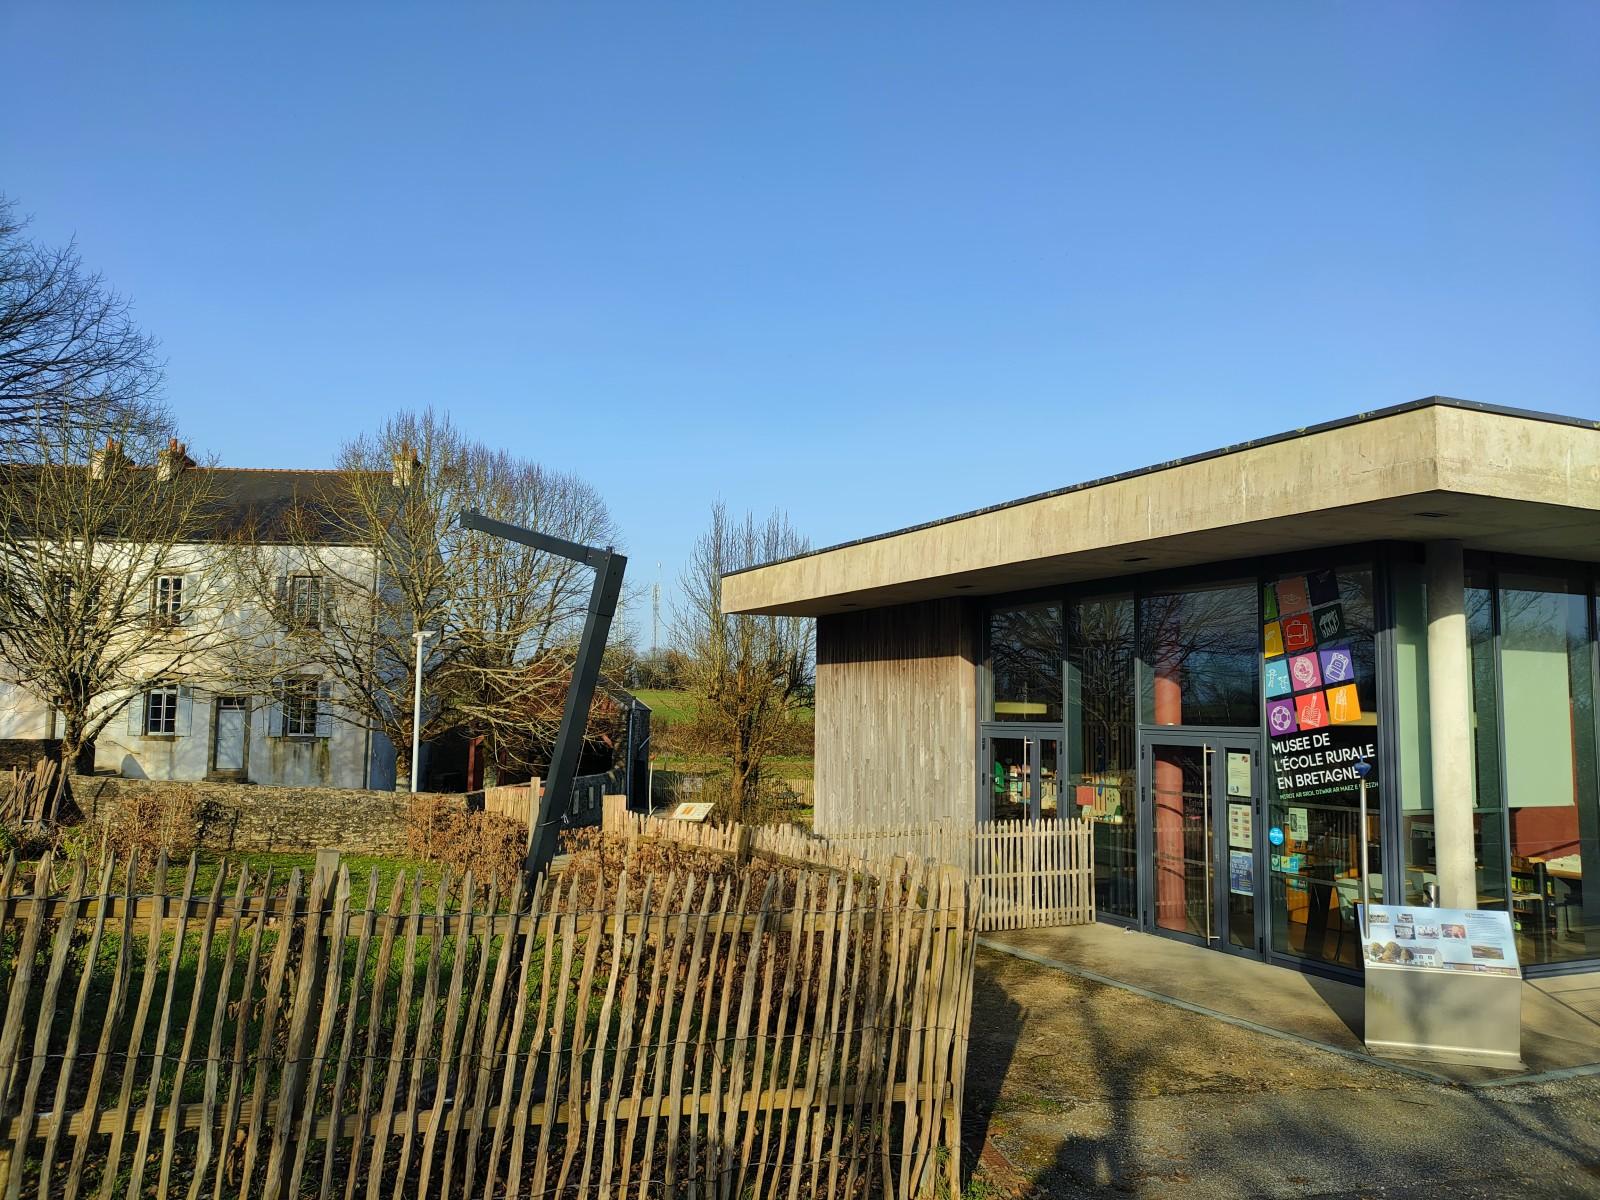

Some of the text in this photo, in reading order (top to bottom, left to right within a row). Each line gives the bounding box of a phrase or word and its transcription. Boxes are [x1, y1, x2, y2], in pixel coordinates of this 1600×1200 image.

[1271, 732, 1331, 755] MUSEE DE
[1274, 743, 1376, 773] L'ÉCOLE RURALE
[1277, 765, 1361, 790] EN BRETAGNE
[1340, 784, 1354, 792] MAEZ
